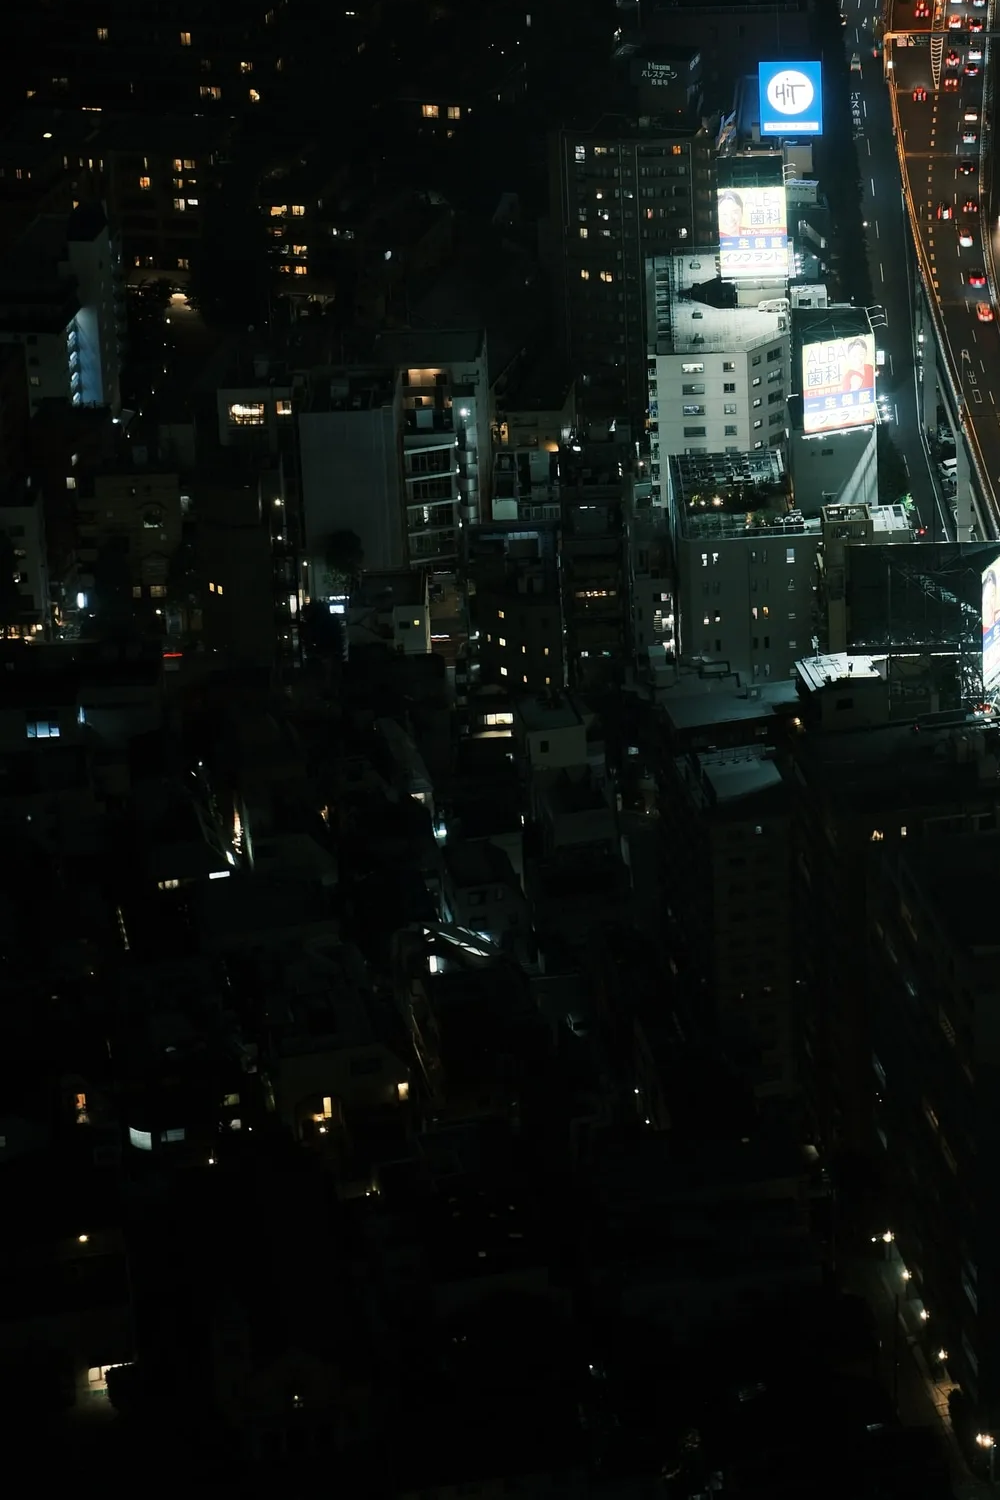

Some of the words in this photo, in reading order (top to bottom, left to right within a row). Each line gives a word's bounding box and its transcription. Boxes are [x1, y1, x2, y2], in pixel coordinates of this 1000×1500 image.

[750, 208, 782, 226] 歯科
[722, 237, 783, 249] 一生保証
[722, 252, 783, 263] インプラント
[806, 343, 847, 366] ALBA
[807, 363, 843, 387] 歯科
[807, 390, 871, 410] 一生保証
